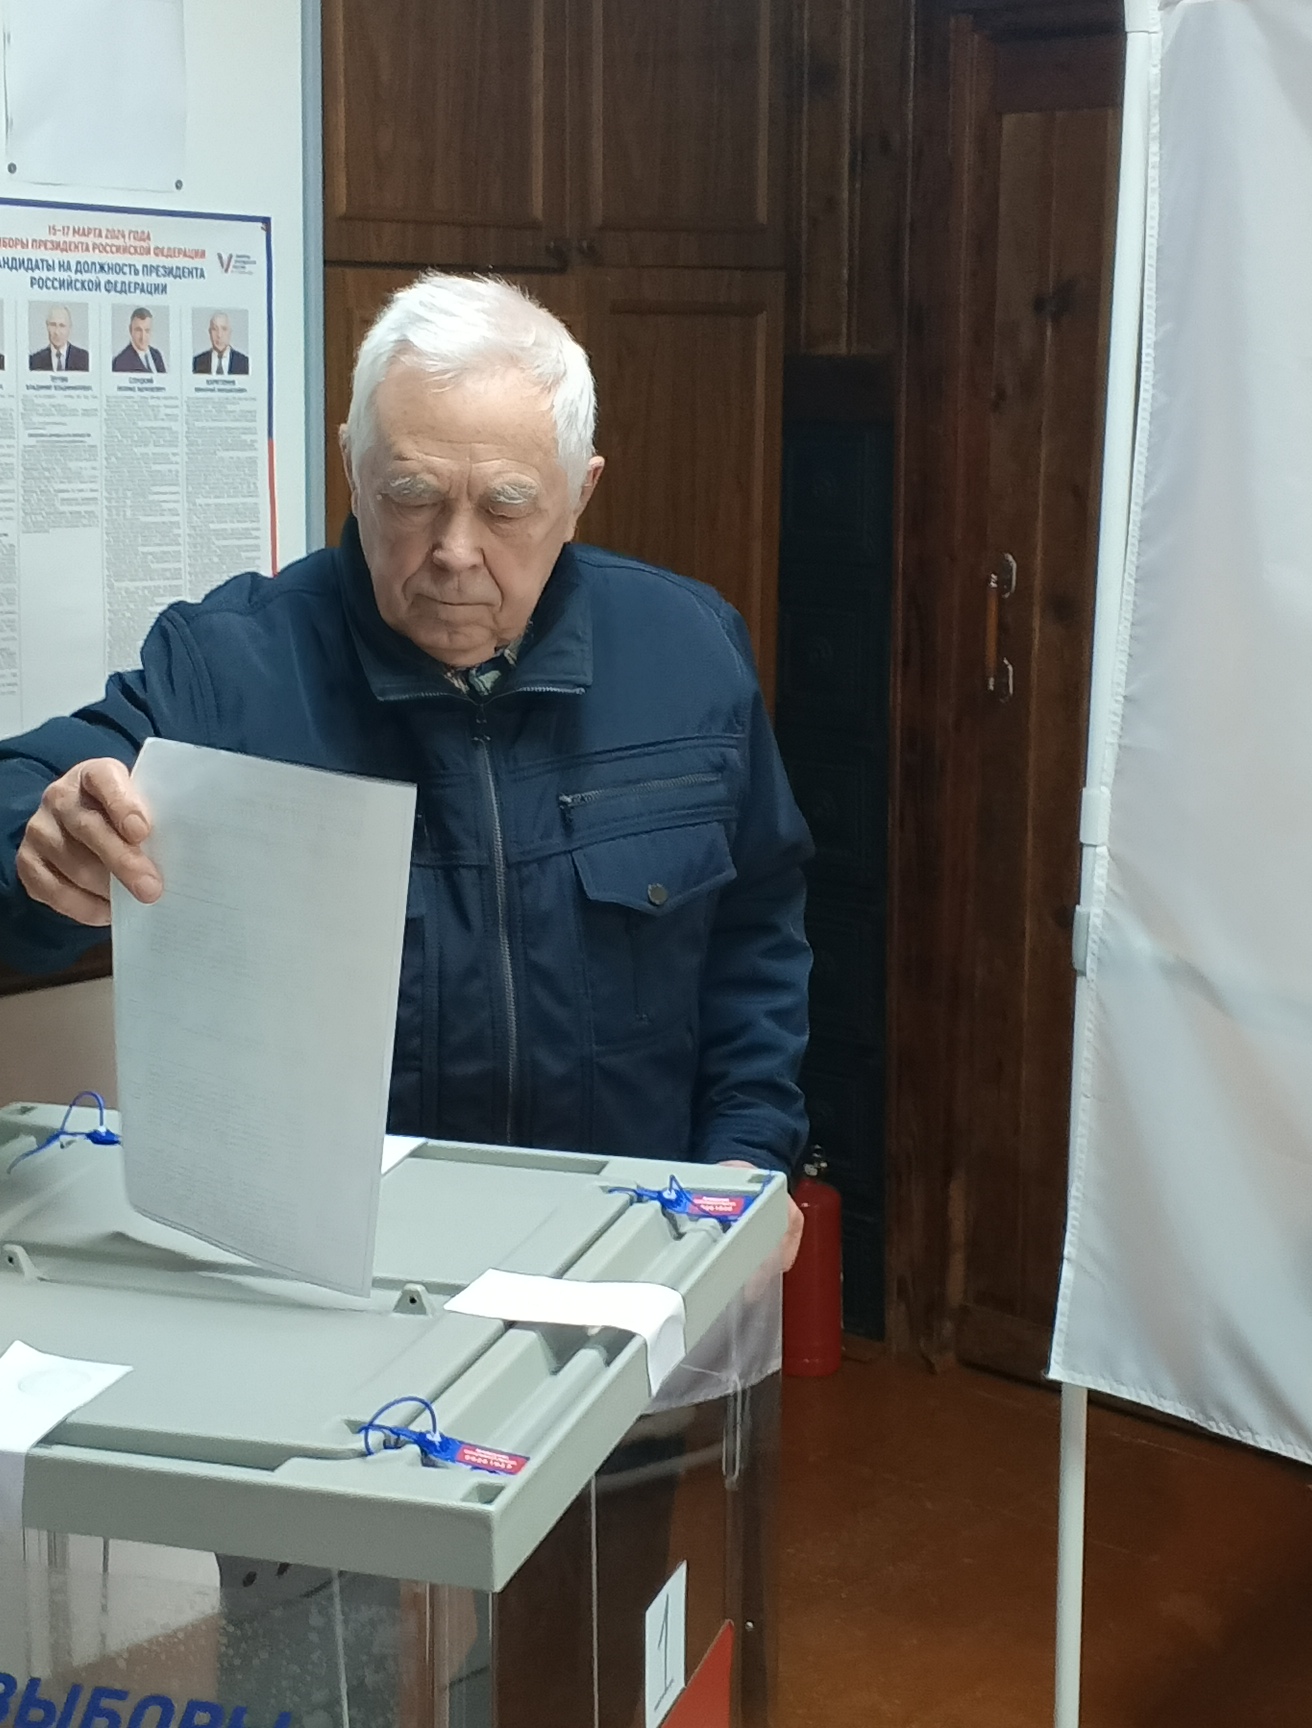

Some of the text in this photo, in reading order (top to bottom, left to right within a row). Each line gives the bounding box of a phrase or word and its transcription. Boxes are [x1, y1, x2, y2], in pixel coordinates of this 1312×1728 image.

[72, 225, 103, 239] МАРТА
[128, 230, 151, 243] ГОДА
[31, 238, 91, 254] ПРЕЗИДЕНТА
[92, 241, 152, 256] РОССИЙСКОЙ
[153, 246, 206, 260] ФЕДЕРАЦИИ
[58, 259, 73, 273] НА
[74, 260, 140, 276] ДОЛЖНОСТЬ
[142, 264, 206, 280] ПРЕЗИДЕНТА
[30, 275, 168, 296] РОССИЙСКОЙ ФЕДЕРАЦИИ
